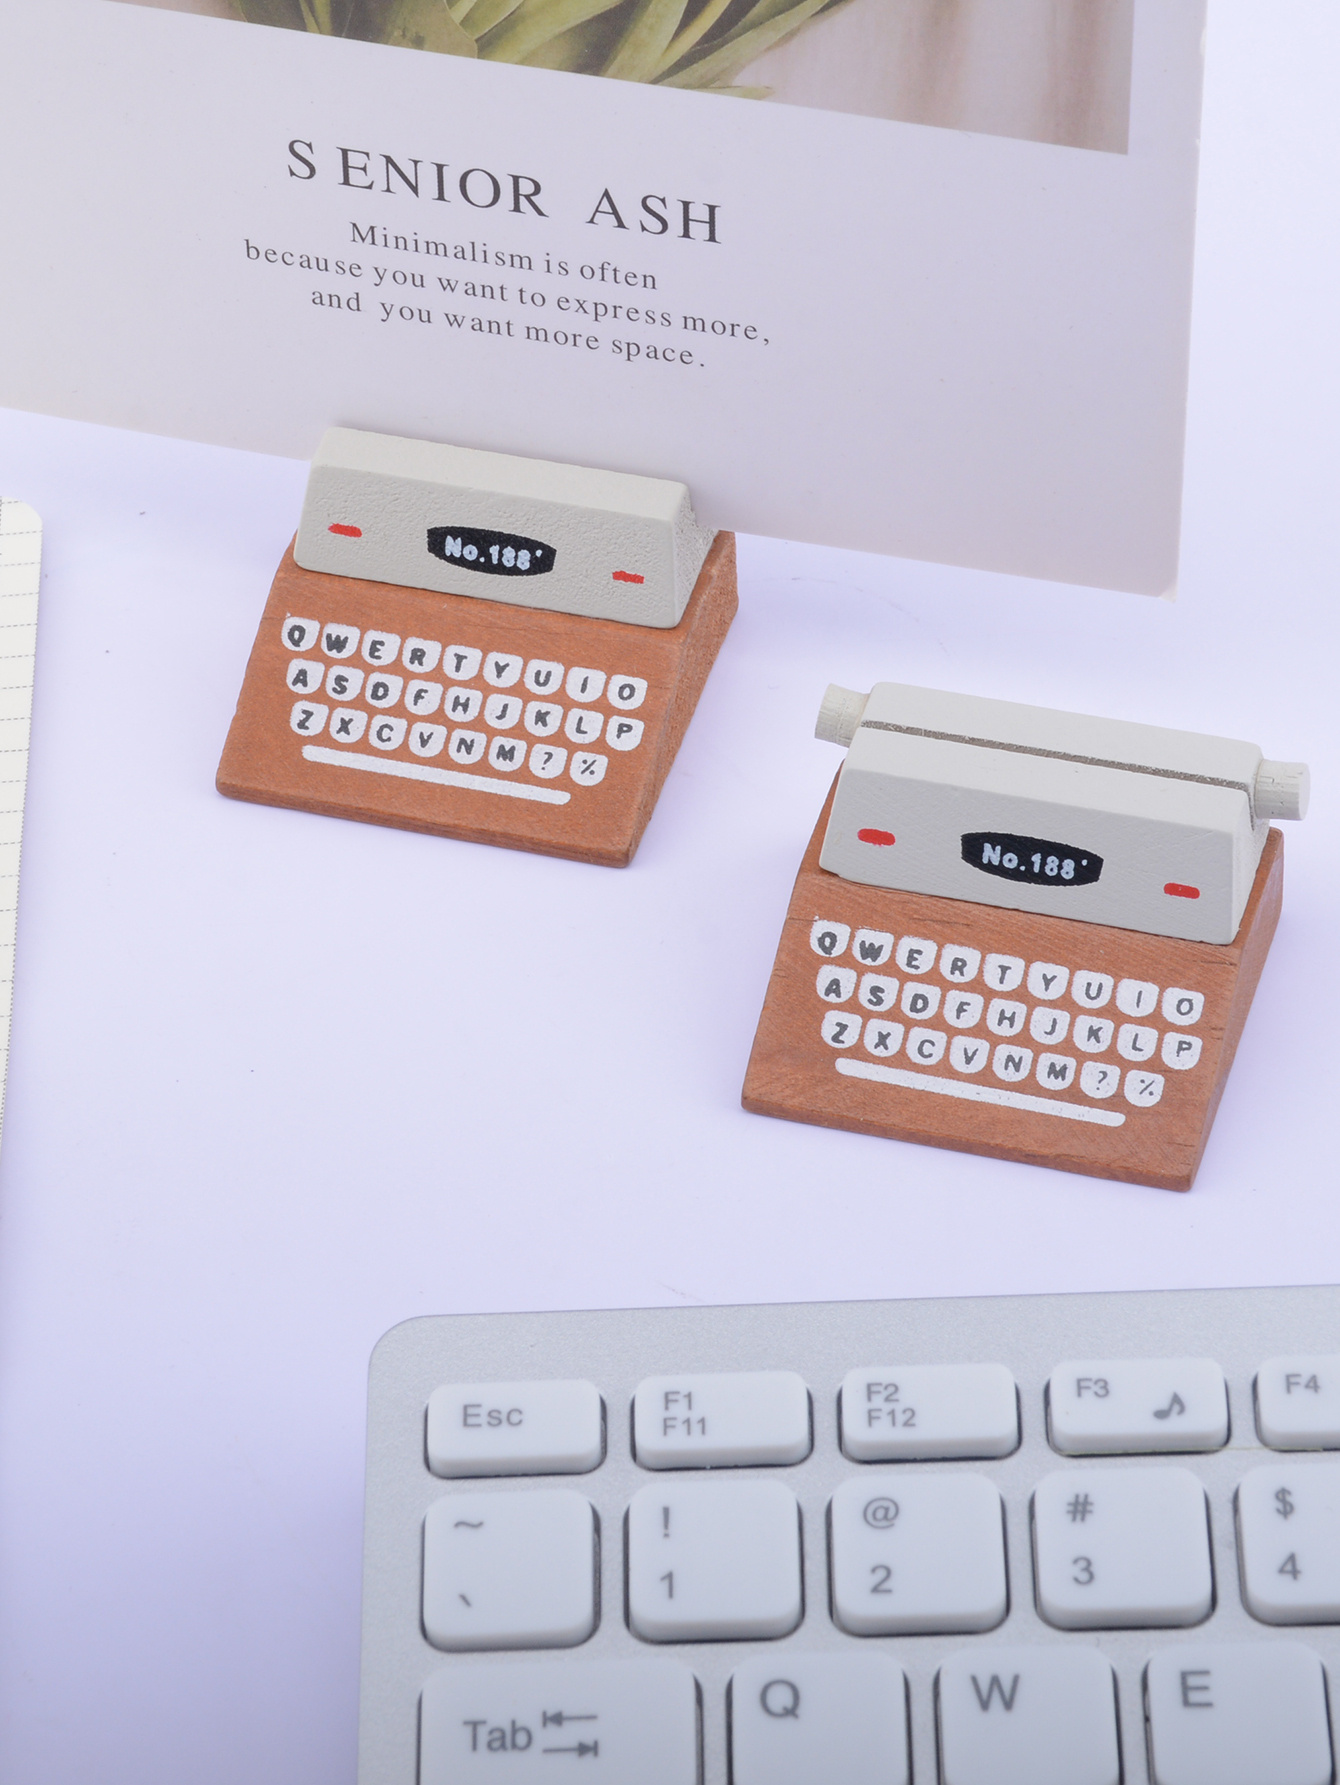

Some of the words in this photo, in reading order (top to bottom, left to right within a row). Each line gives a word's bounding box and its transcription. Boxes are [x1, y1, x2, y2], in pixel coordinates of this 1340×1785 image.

[586, 188, 720, 244] ASH
[349, 222, 533, 271] Minimalism
[545, 253, 568, 275] is
[580, 262, 656, 289] often
[244, 238, 364, 278] because
[374, 267, 424, 288] you
[438, 277, 507, 301] want
[519, 288, 545, 306] to
[557, 297, 671, 326] express
[683, 316, 768, 345] more,
[312, 292, 361, 311] and
[381, 303, 431, 323] you
[444, 313, 514, 337] want
[526, 326, 599, 349] more
[612, 340, 704, 367] space.
[287, 624, 306, 648] Q
[325, 632, 349, 654] W
[368, 639, 386, 661] E
[408, 647, 427, 667] R
[453, 652, 468, 674] T
[494, 660, 510, 680] Y
[533, 669, 552, 688] U
[617, 683, 636, 702] O
[291, 668, 309, 688] A
[331, 674, 350, 696] S
[370, 681, 390, 702] D
[413, 688, 429, 707] F
[451, 694, 471, 715] H
[495, 703, 509, 721] J
[534, 709, 551, 728] K
[575, 715, 588, 735] L
[615, 722, 634, 740] P
[296, 708, 315, 731] Z
[335, 717, 354, 736] X
[375, 723, 395, 744] C
[418, 731, 434, 749] V
[455, 737, 475, 756] N
[495, 743, 516, 763] M
[816, 931, 838, 956] Q
[858, 939, 884, 963] W
[905, 947, 924, 971] E
[949, 956, 968, 977] R
[997, 964, 1012, 985] T
[1041, 972, 1058, 993] Y
[1084, 981, 1104, 1001] U
[1175, 997, 1194, 1017] O
[823, 977, 842, 999] A
[866, 985, 886, 1007] S
[909, 992, 930, 1014] D
[955, 1000, 972, 1020] F
[996, 1008, 1017, 1029] H
[1043, 1017, 1058, 1036] J
[1086, 1024, 1104, 1044] K
[1131, 1032, 1144, 1053] L
[1175, 1039, 1193, 1058] P
[830, 1021, 849, 1045] Z
[873, 1030, 892, 1051] X
[917, 1038, 936, 1059] C
[963, 1046, 979, 1066] V
[1003, 1054, 1024, 1073] N
[1046, 1061, 1069, 1082] M
[663, 1390, 693, 1412] F1
[865, 1382, 900, 1404] F2
[1075, 1377, 1111, 1399] F3
[1284, 1373, 1321, 1395] F4
[462, 1403, 524, 1429] Esc
[662, 1416, 706, 1437] F11
[866, 1407, 917, 1428] F12
[862, 1496, 900, 1530] @
[1066, 1493, 1094, 1523] #
[1274, 1486, 1295, 1521] $
[662, 1506, 671, 1539] !
[869, 1564, 893, 1595] 2
[1072, 1556, 1096, 1587] 3
[1277, 1551, 1302, 1581] 4
[659, 1570, 675, 1600] 1
[759, 1678, 801, 1720] Q
[970, 1673, 1020, 1713] W
[1179, 1669, 1214, 1709] E
[462, 1719, 534, 1753] Tab
